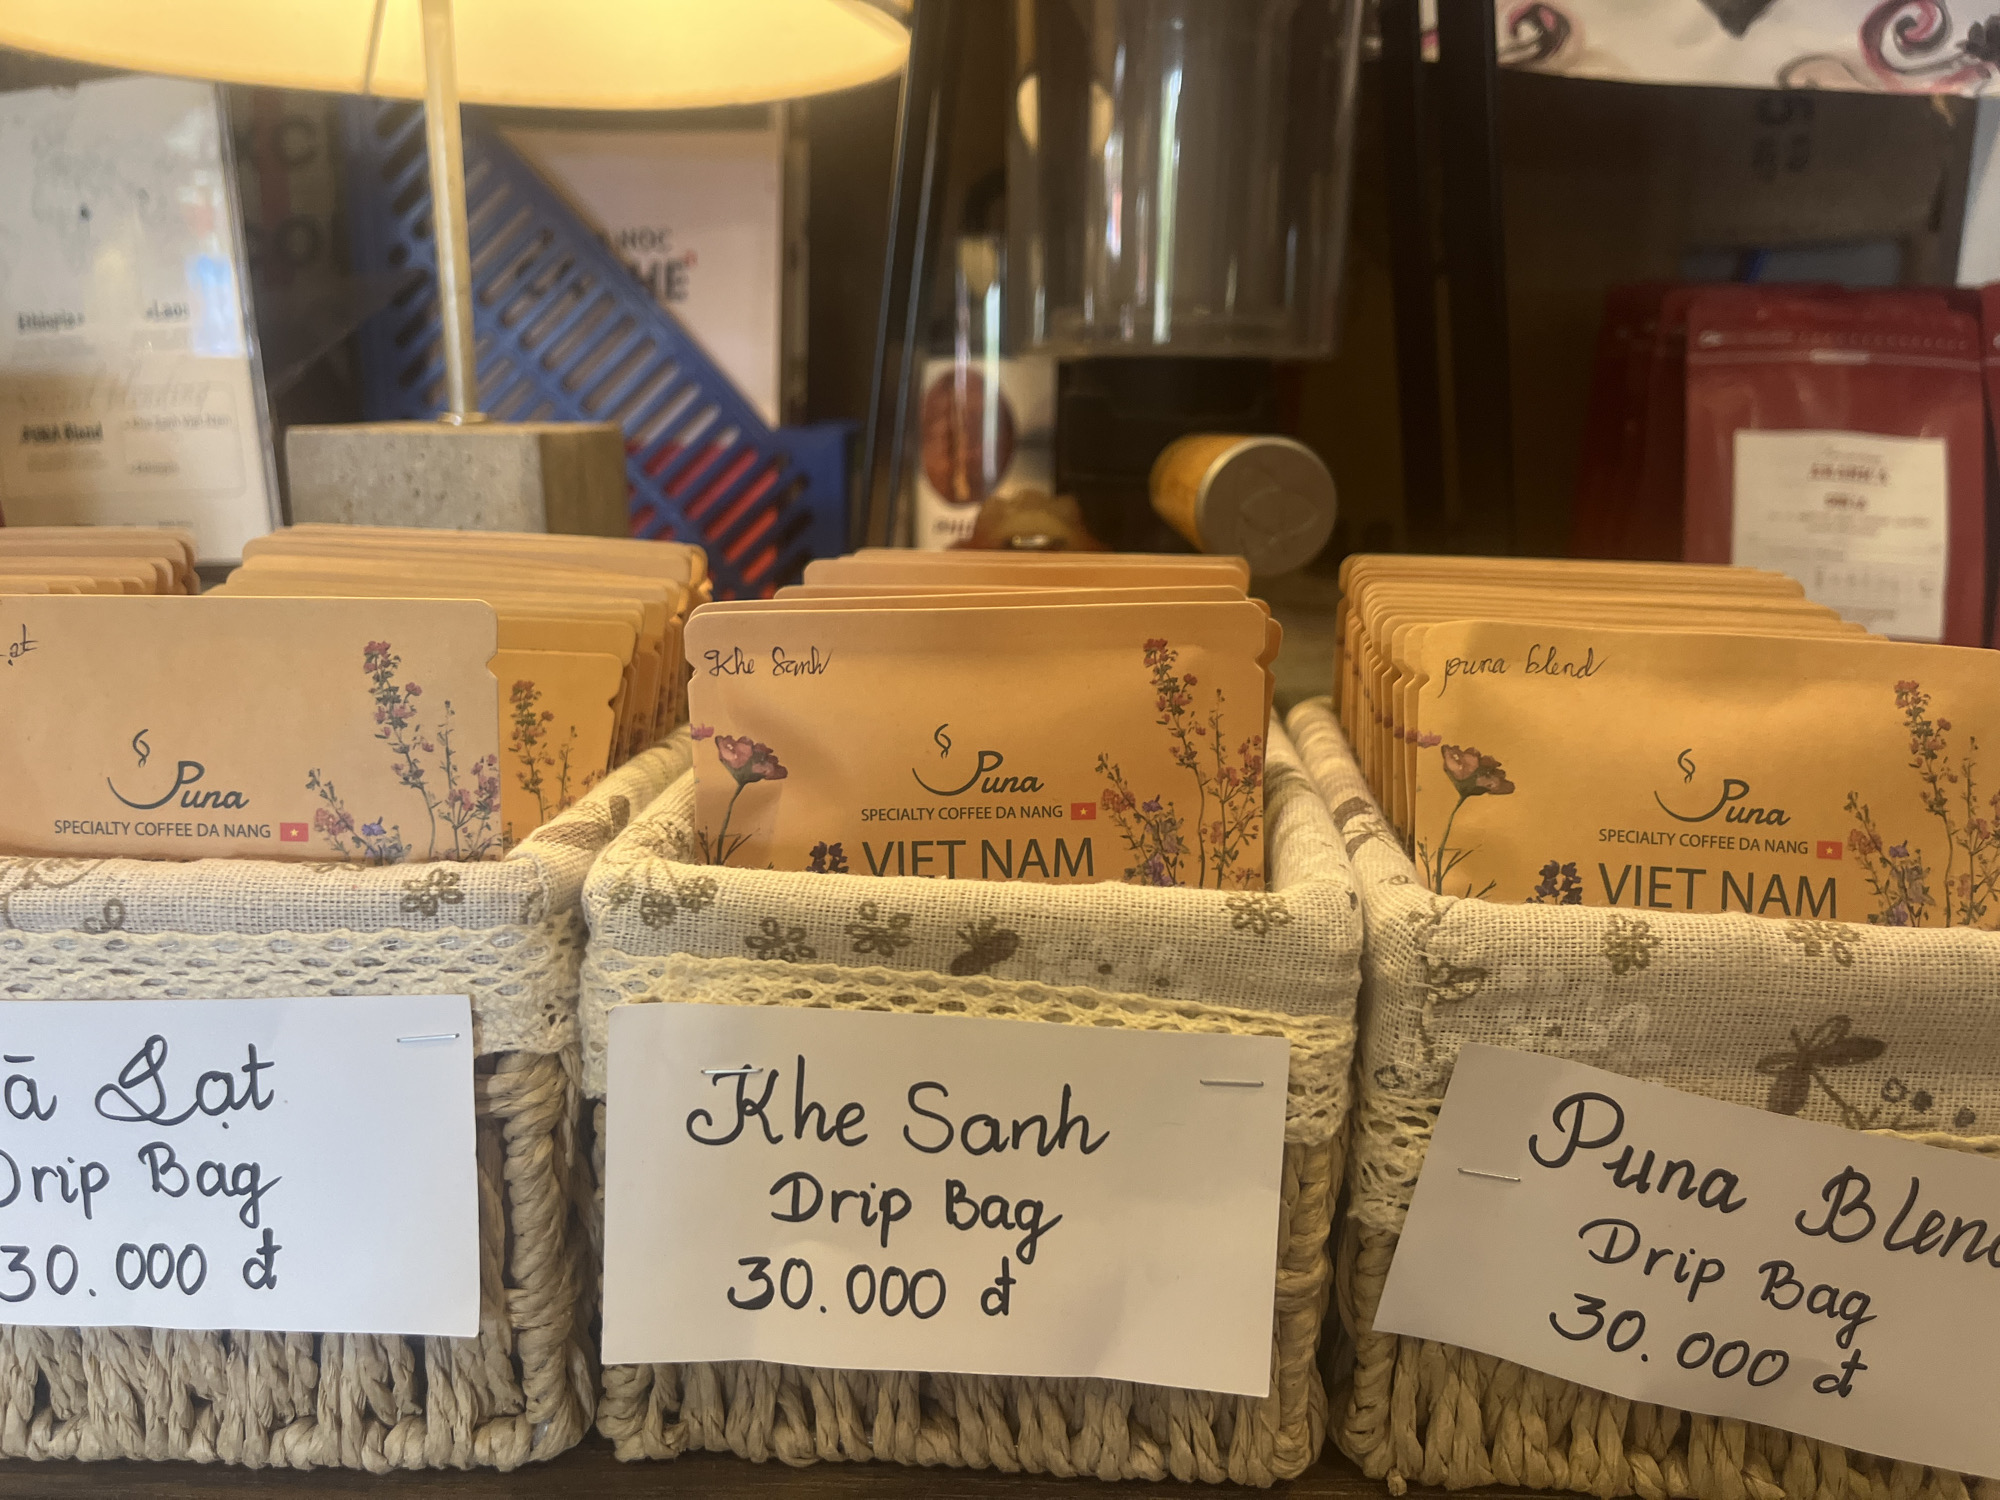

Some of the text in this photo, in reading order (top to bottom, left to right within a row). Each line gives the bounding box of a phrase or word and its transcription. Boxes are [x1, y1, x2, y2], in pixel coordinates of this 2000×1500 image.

[0, 624, 38, 666] ạt
[704, 646, 832, 676] Khe Sanh
[1525, 644, 1609, 679] blend
[107, 760, 249, 810] Puna
[912, 750, 1044, 796] Puna
[861, 804, 1063, 822] SPECIALTY COFFEE DA NANG
[1654, 779, 1791, 826] Puna
[54, 819, 271, 839] SPECIALTY COFFEE DA NANG
[1598, 828, 1809, 855] SPECIALTY COFFEE DA NANG
[861, 837, 1094, 879] VIET NAM
[1598, 862, 1838, 919] VIET NAM
[686, 1054, 1110, 1157] Khe Sanh
[1528, 1089, 1748, 1214] Puna
[138, 1141, 282, 1229] Bag
[769, 1171, 1063, 1265] Drip Bag
[0, 1243, 207, 1302] 30.000
[727, 1256, 946, 1319] 30.000
[1578, 1218, 1877, 1349] Drip Bag
[1549, 1293, 1789, 1387] 30.000
